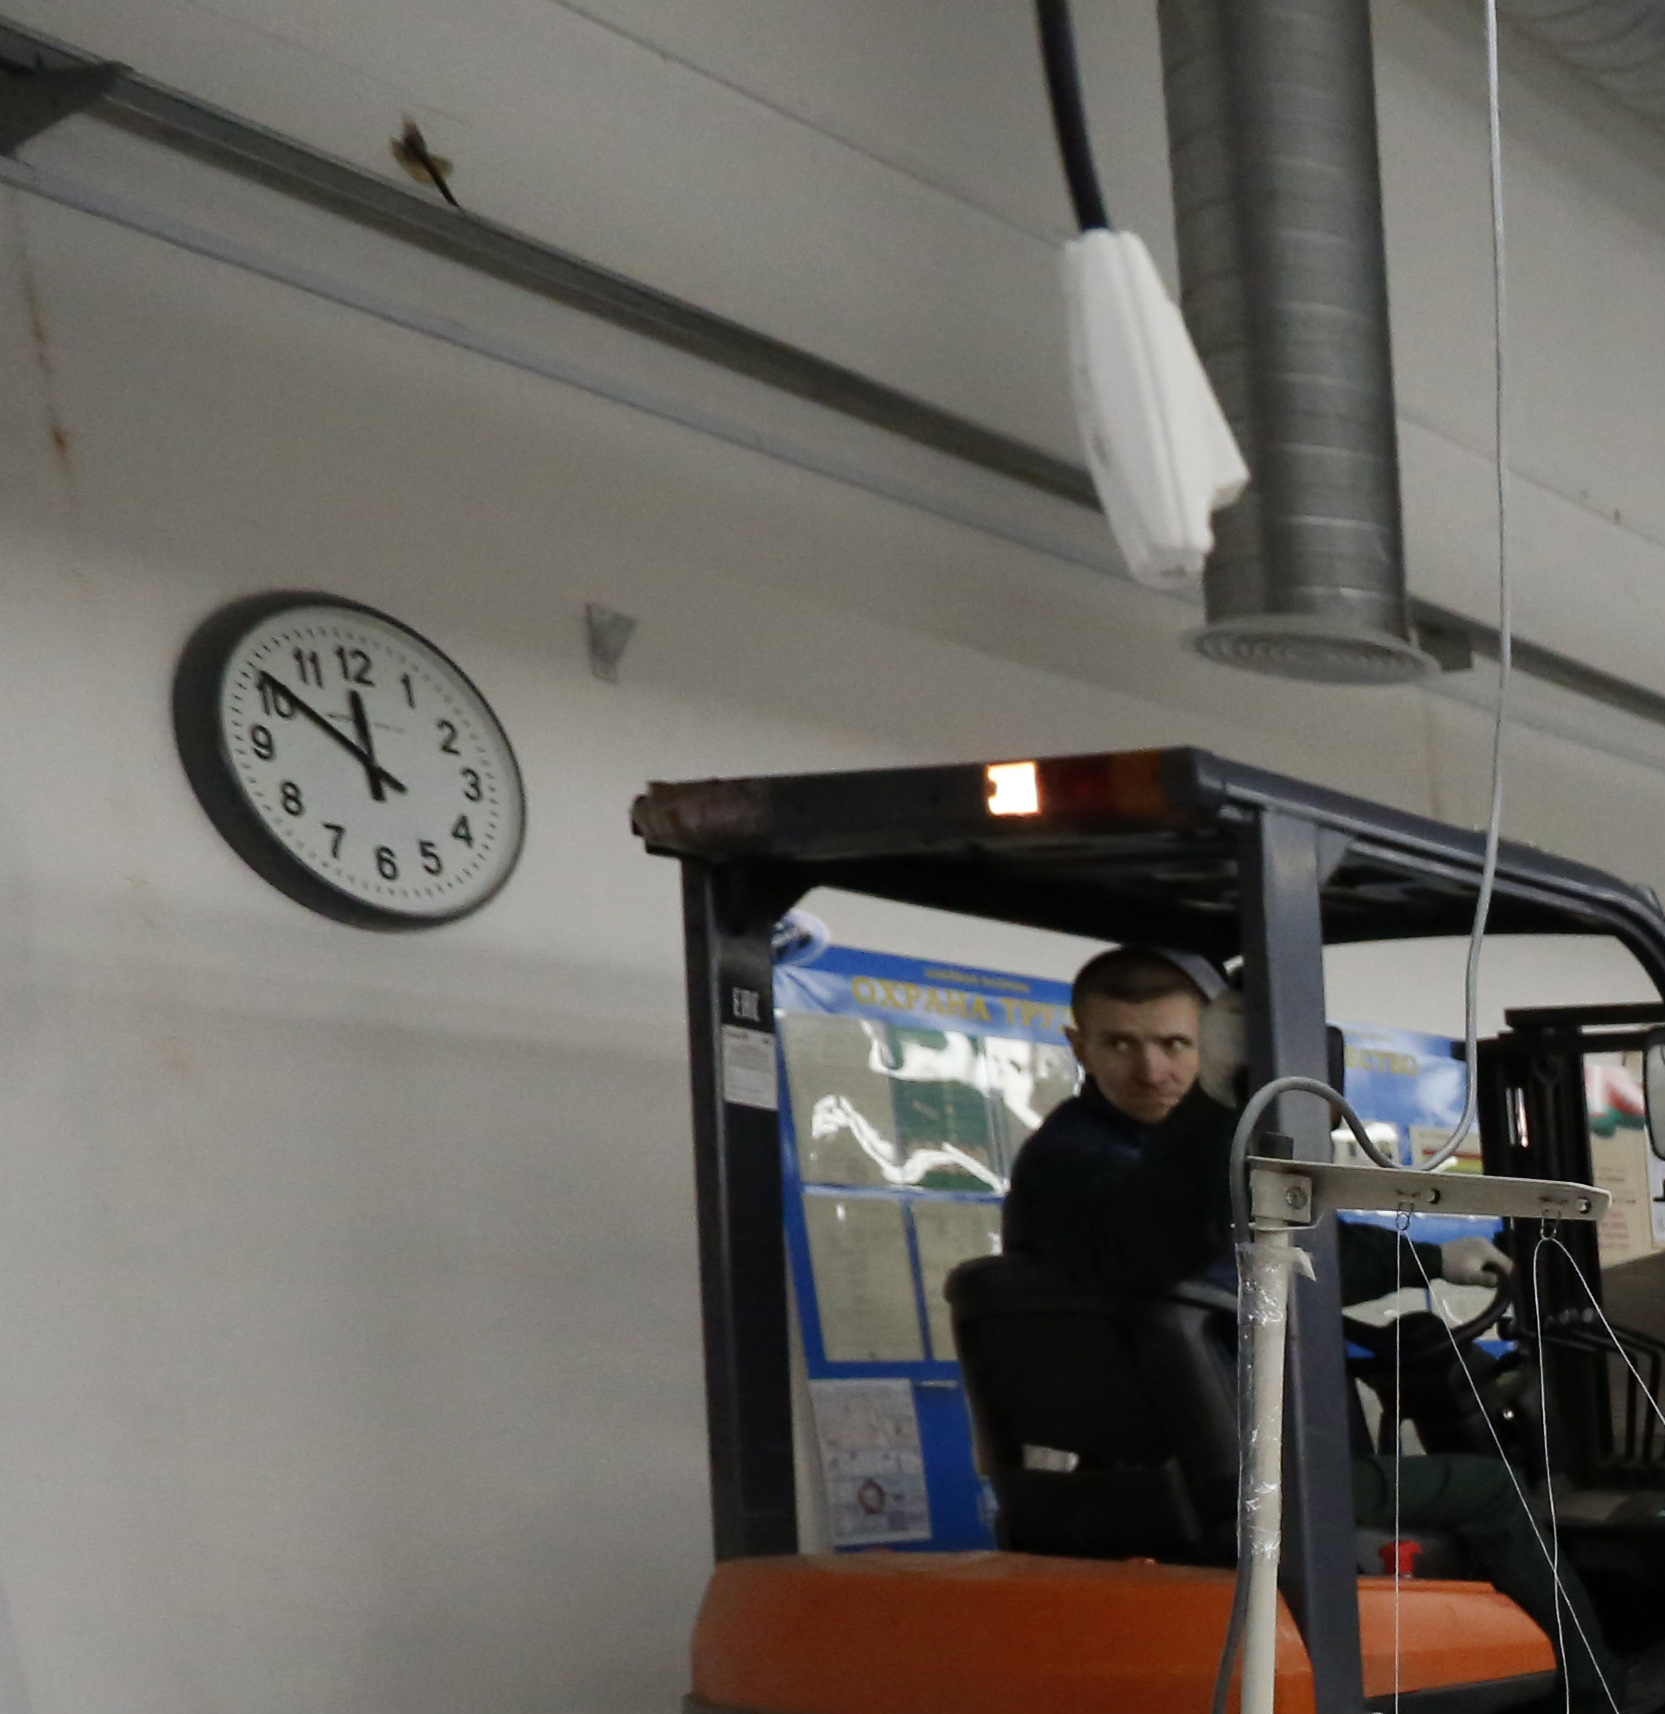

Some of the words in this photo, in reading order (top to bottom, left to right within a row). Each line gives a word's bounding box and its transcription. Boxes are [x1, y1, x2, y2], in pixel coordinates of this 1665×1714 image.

[293, 646, 324, 689] 11
[334, 645, 374, 688] 12
[400, 673, 416, 709] 1
[250, 724, 275, 760] 9
[436, 718, 460, 756] 2
[280, 781, 303, 816] 8
[460, 766, 482, 802] 3
[322, 821, 345, 860] 7
[451, 814, 473, 848] 4
[375, 845, 398, 880] 6
[418, 838, 442, 875] 5
[851, 974, 991, 1022] ОХРАНА
[1001, 997, 1071, 1034] ТРУ
